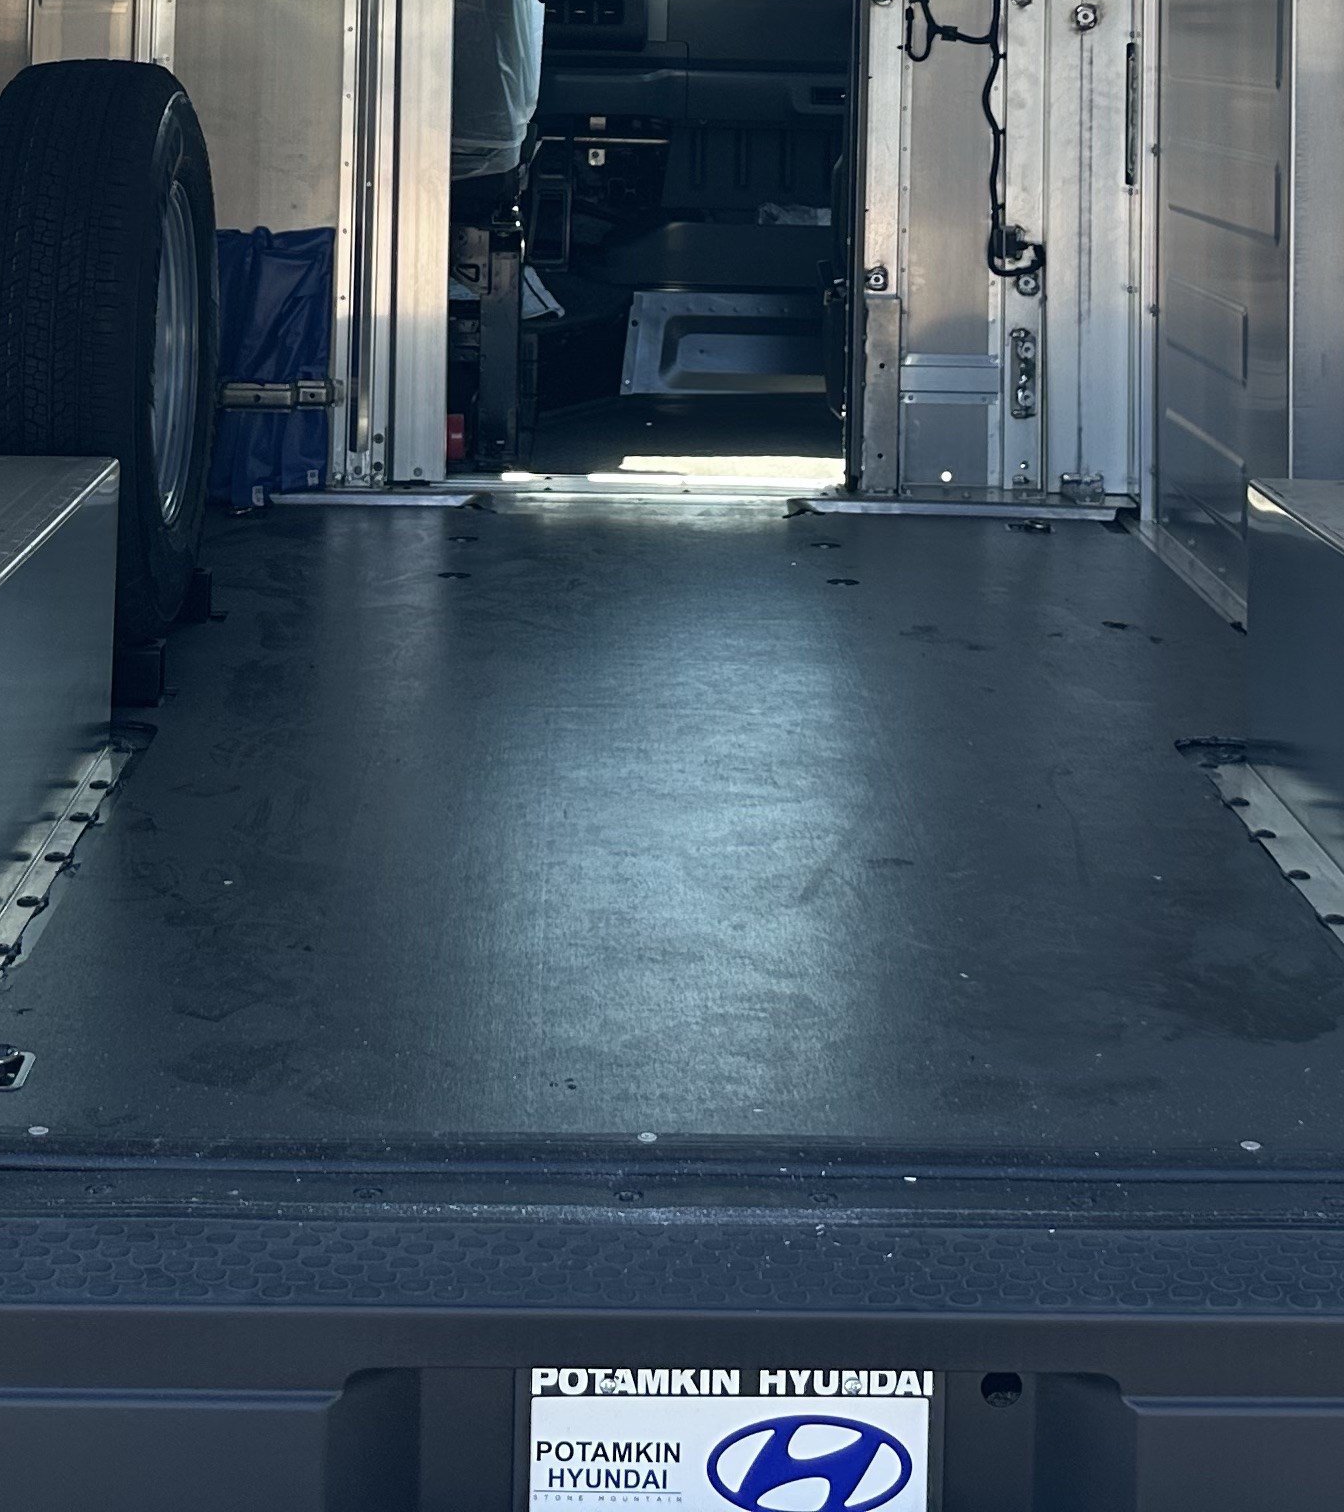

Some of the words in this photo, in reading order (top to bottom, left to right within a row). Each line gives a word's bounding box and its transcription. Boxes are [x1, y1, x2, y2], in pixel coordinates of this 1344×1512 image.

[531, 1368, 741, 1396] POTAMKIN
[759, 1369, 934, 1396] HYUNDAI
[536, 1441, 681, 1464] POTAMKIN
[548, 1468, 668, 1490] HYUNDAI
[533, 1494, 584, 1502] STONE
